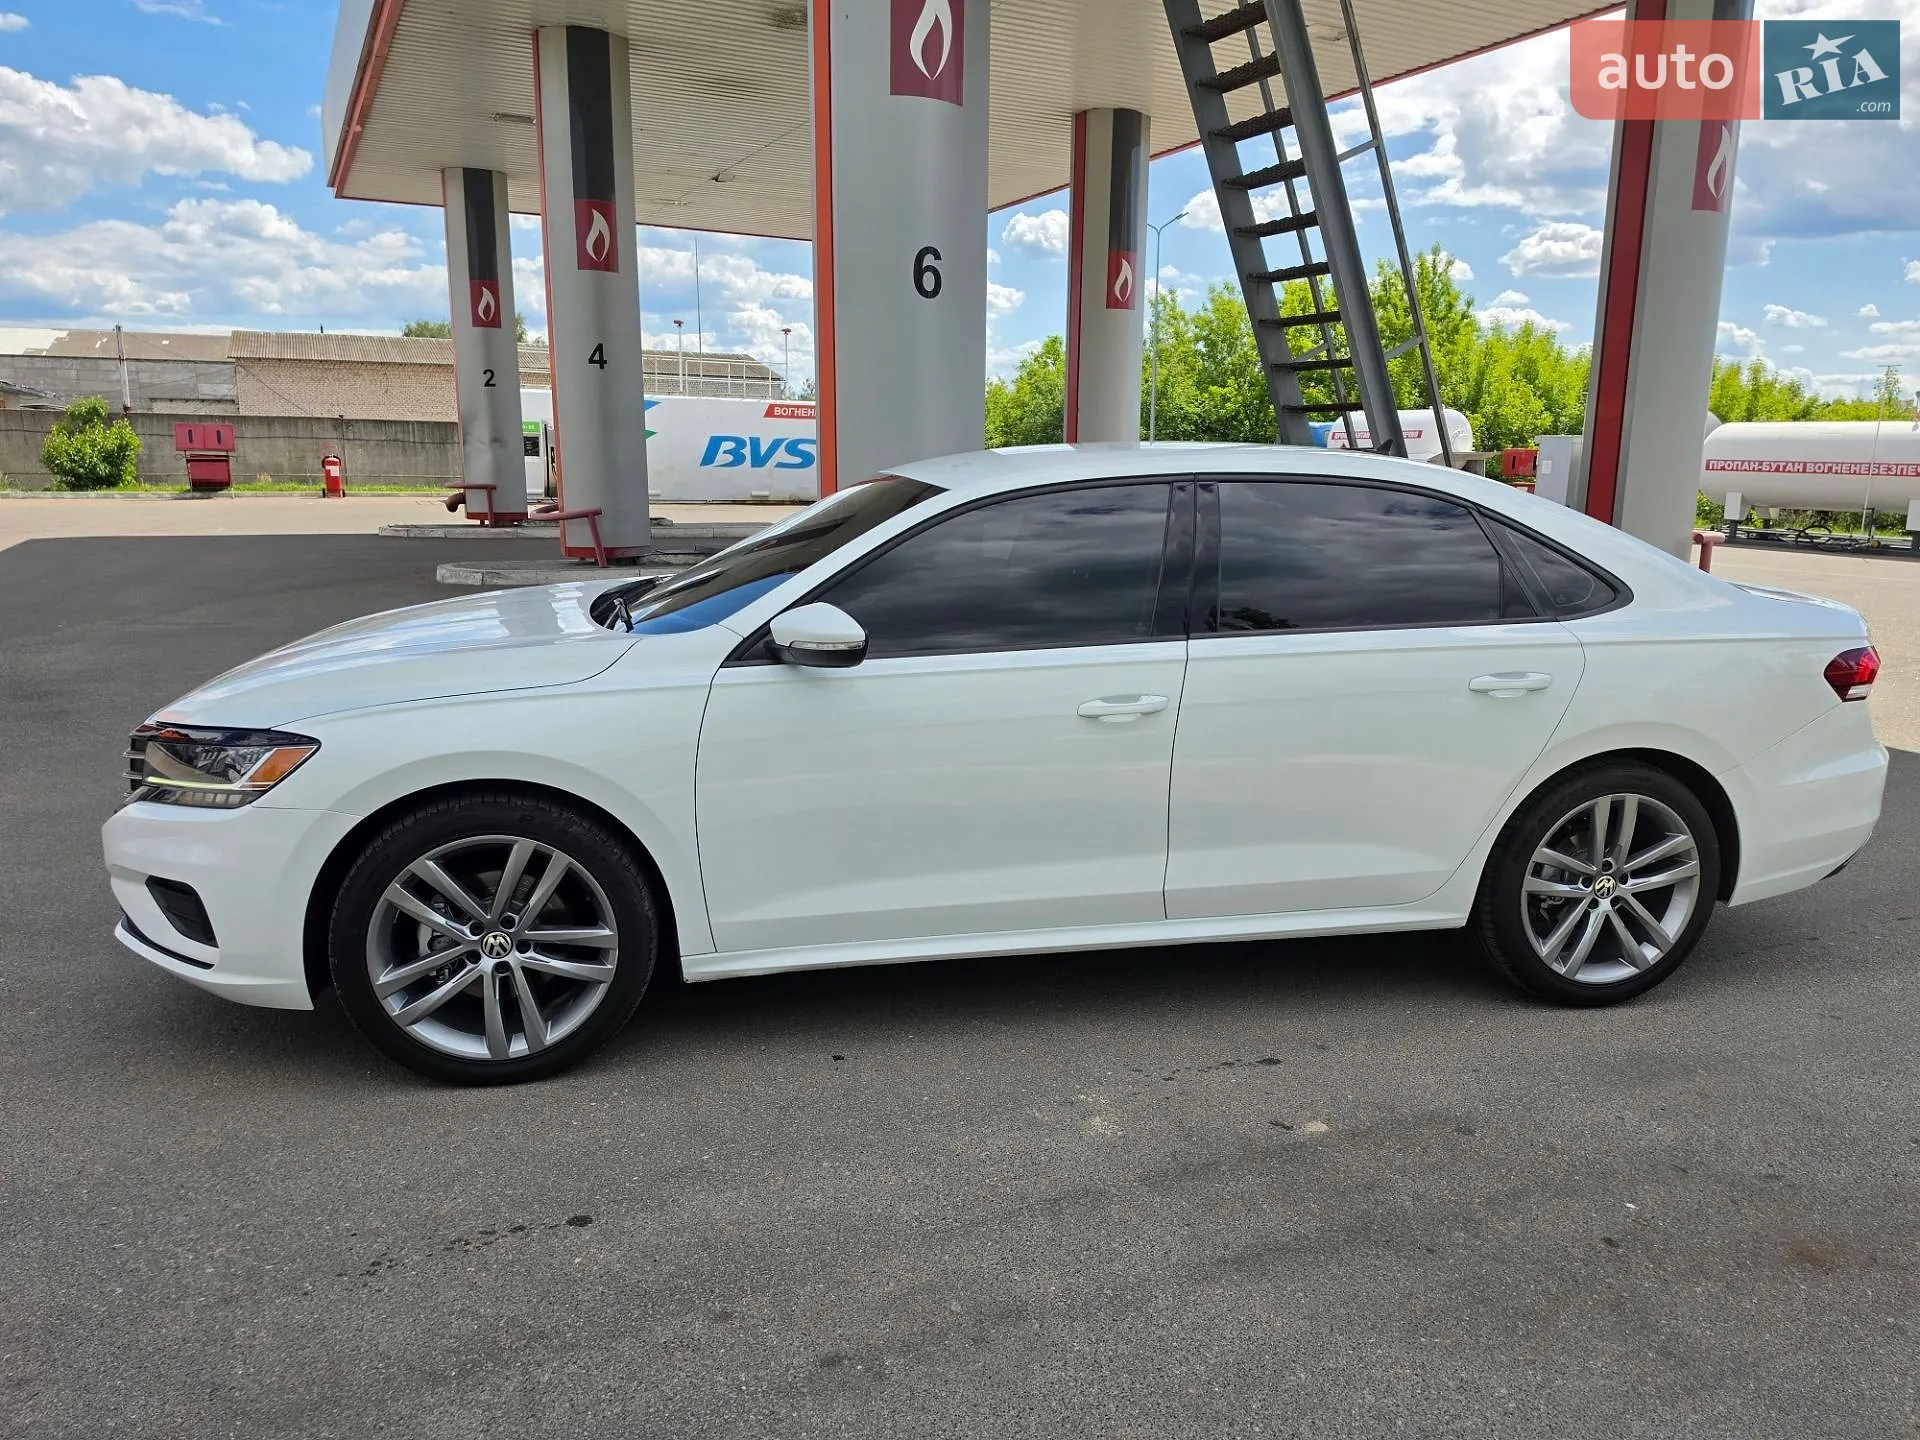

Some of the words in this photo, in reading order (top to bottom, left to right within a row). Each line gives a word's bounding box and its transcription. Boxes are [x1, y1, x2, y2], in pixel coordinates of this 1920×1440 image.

[913, 246, 942, 299] 6
[588, 343, 608, 370] 4
[482, 369, 496, 388] 2
[774, 406, 817, 417] ВОГНЕН
[700, 435, 817, 469] BVS
[1709, 460, 1803, 472] ПРОПАН-БУТАН
